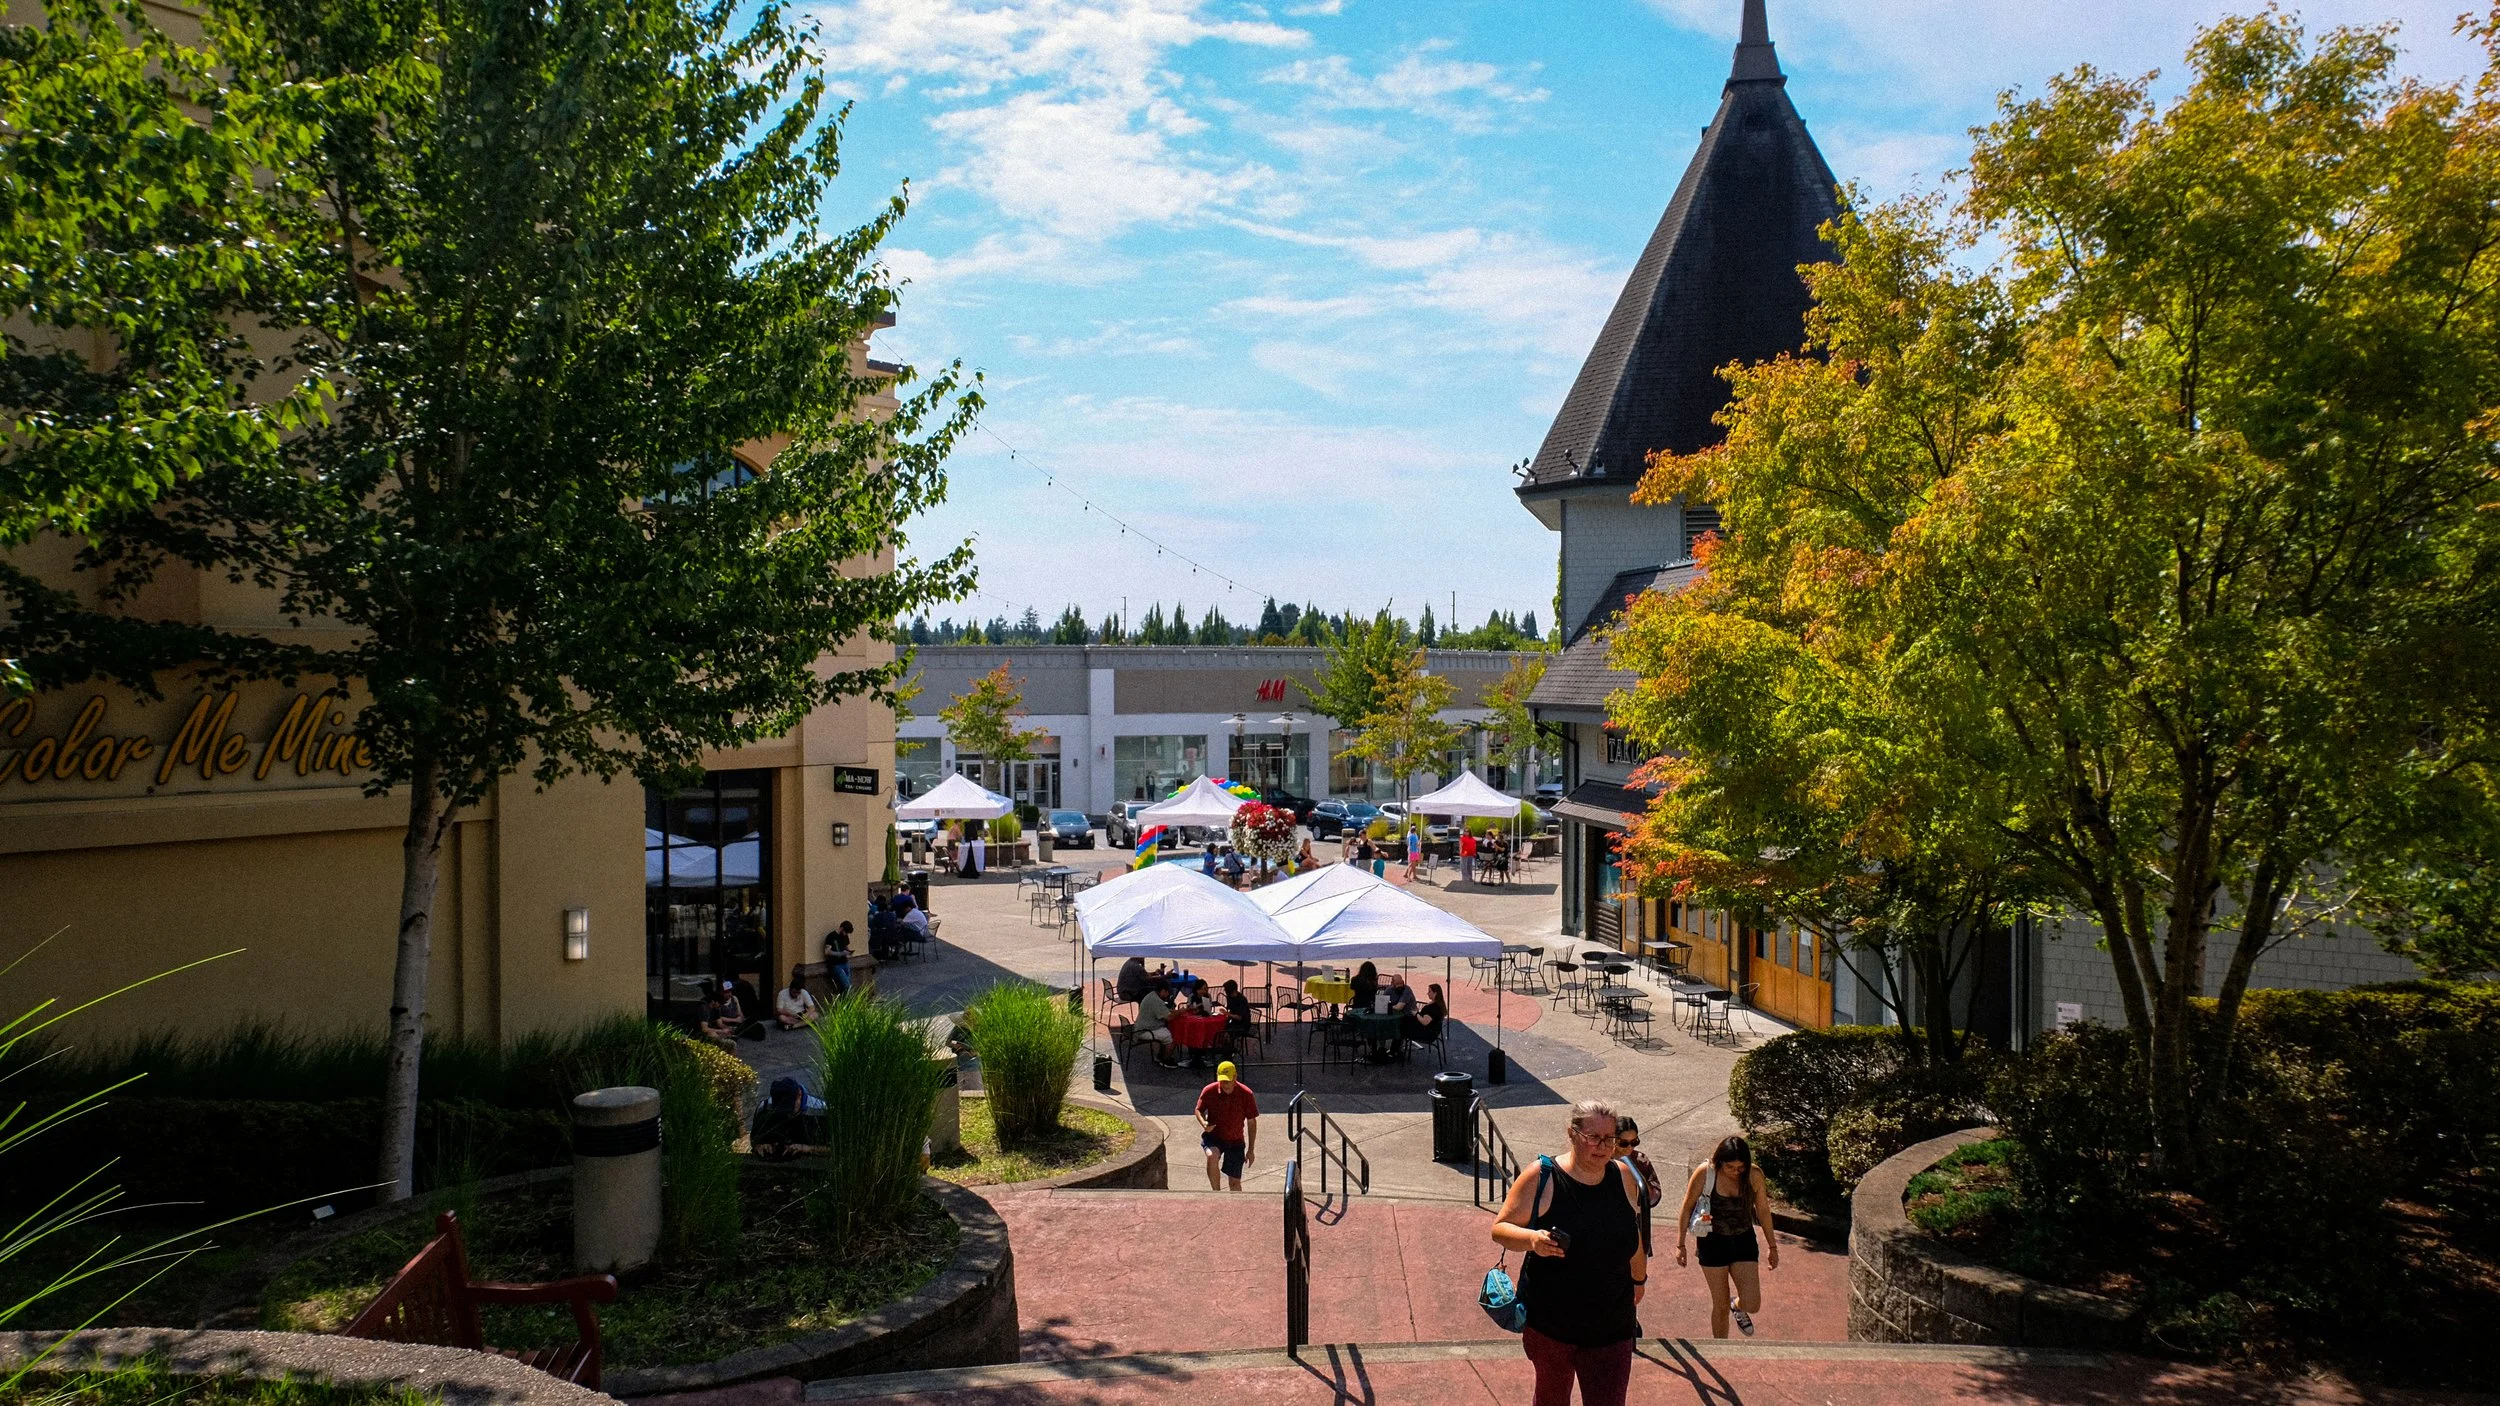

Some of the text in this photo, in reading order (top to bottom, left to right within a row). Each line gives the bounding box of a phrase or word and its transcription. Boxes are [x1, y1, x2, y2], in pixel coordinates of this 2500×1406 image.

[1256, 679, 1286, 702] H&M
[0, 690, 375, 784] Color Me Mine
